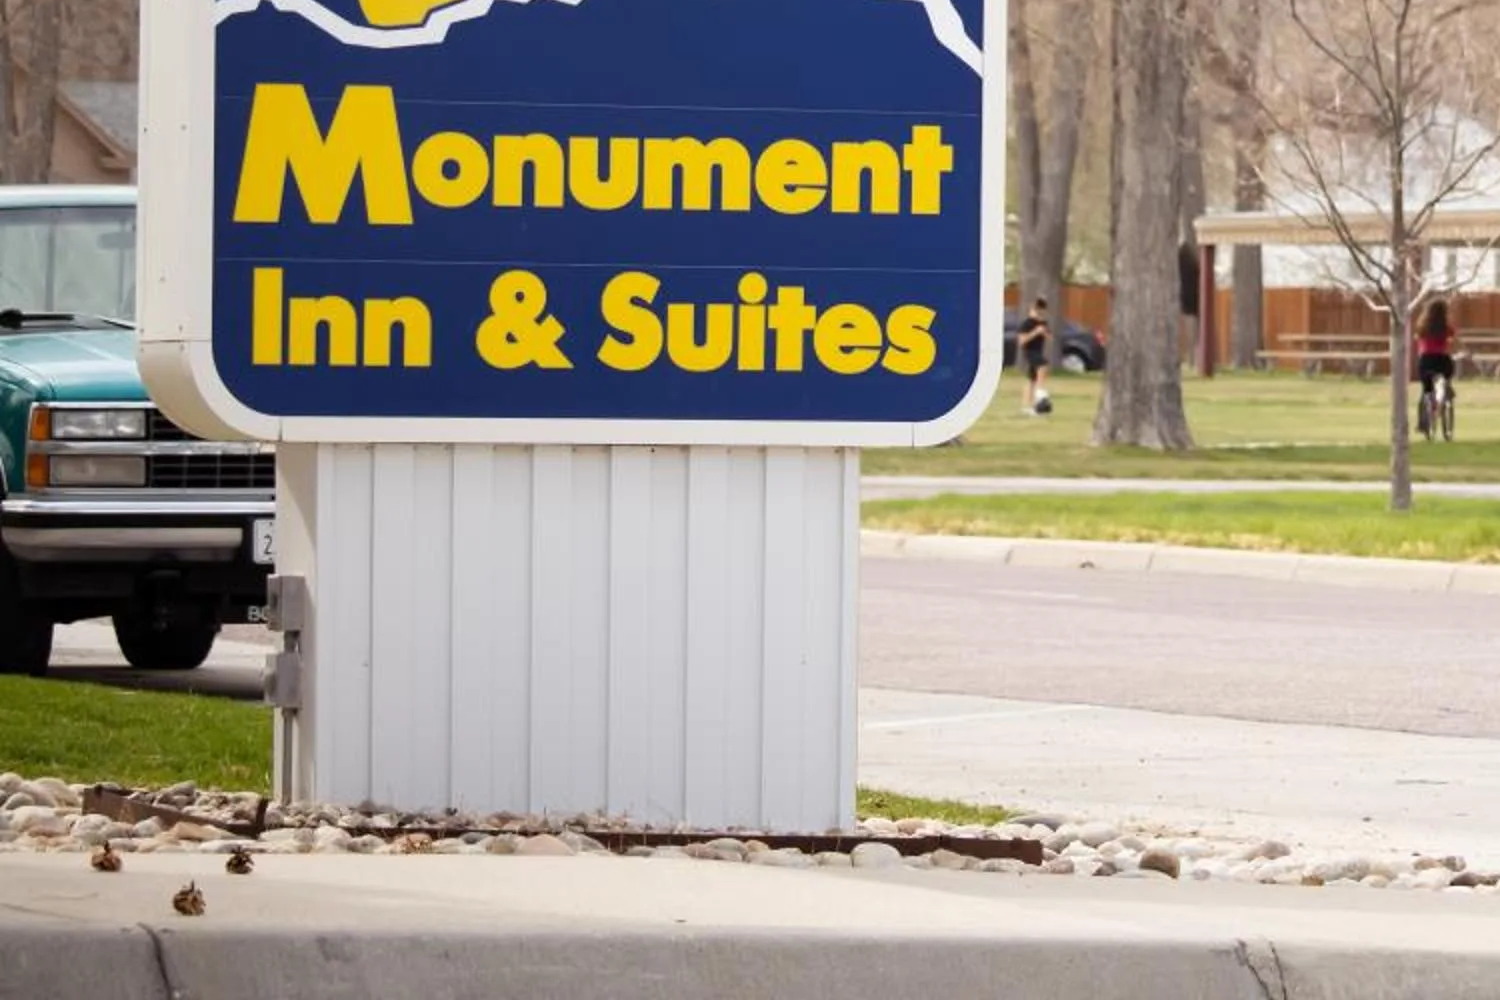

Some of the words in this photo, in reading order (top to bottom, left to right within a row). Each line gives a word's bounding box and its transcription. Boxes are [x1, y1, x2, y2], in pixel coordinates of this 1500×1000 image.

[234, 83, 954, 225] Monument
[252, 267, 431, 367] Inn
[476, 270, 573, 370] &
[597, 272, 937, 375] Suites
